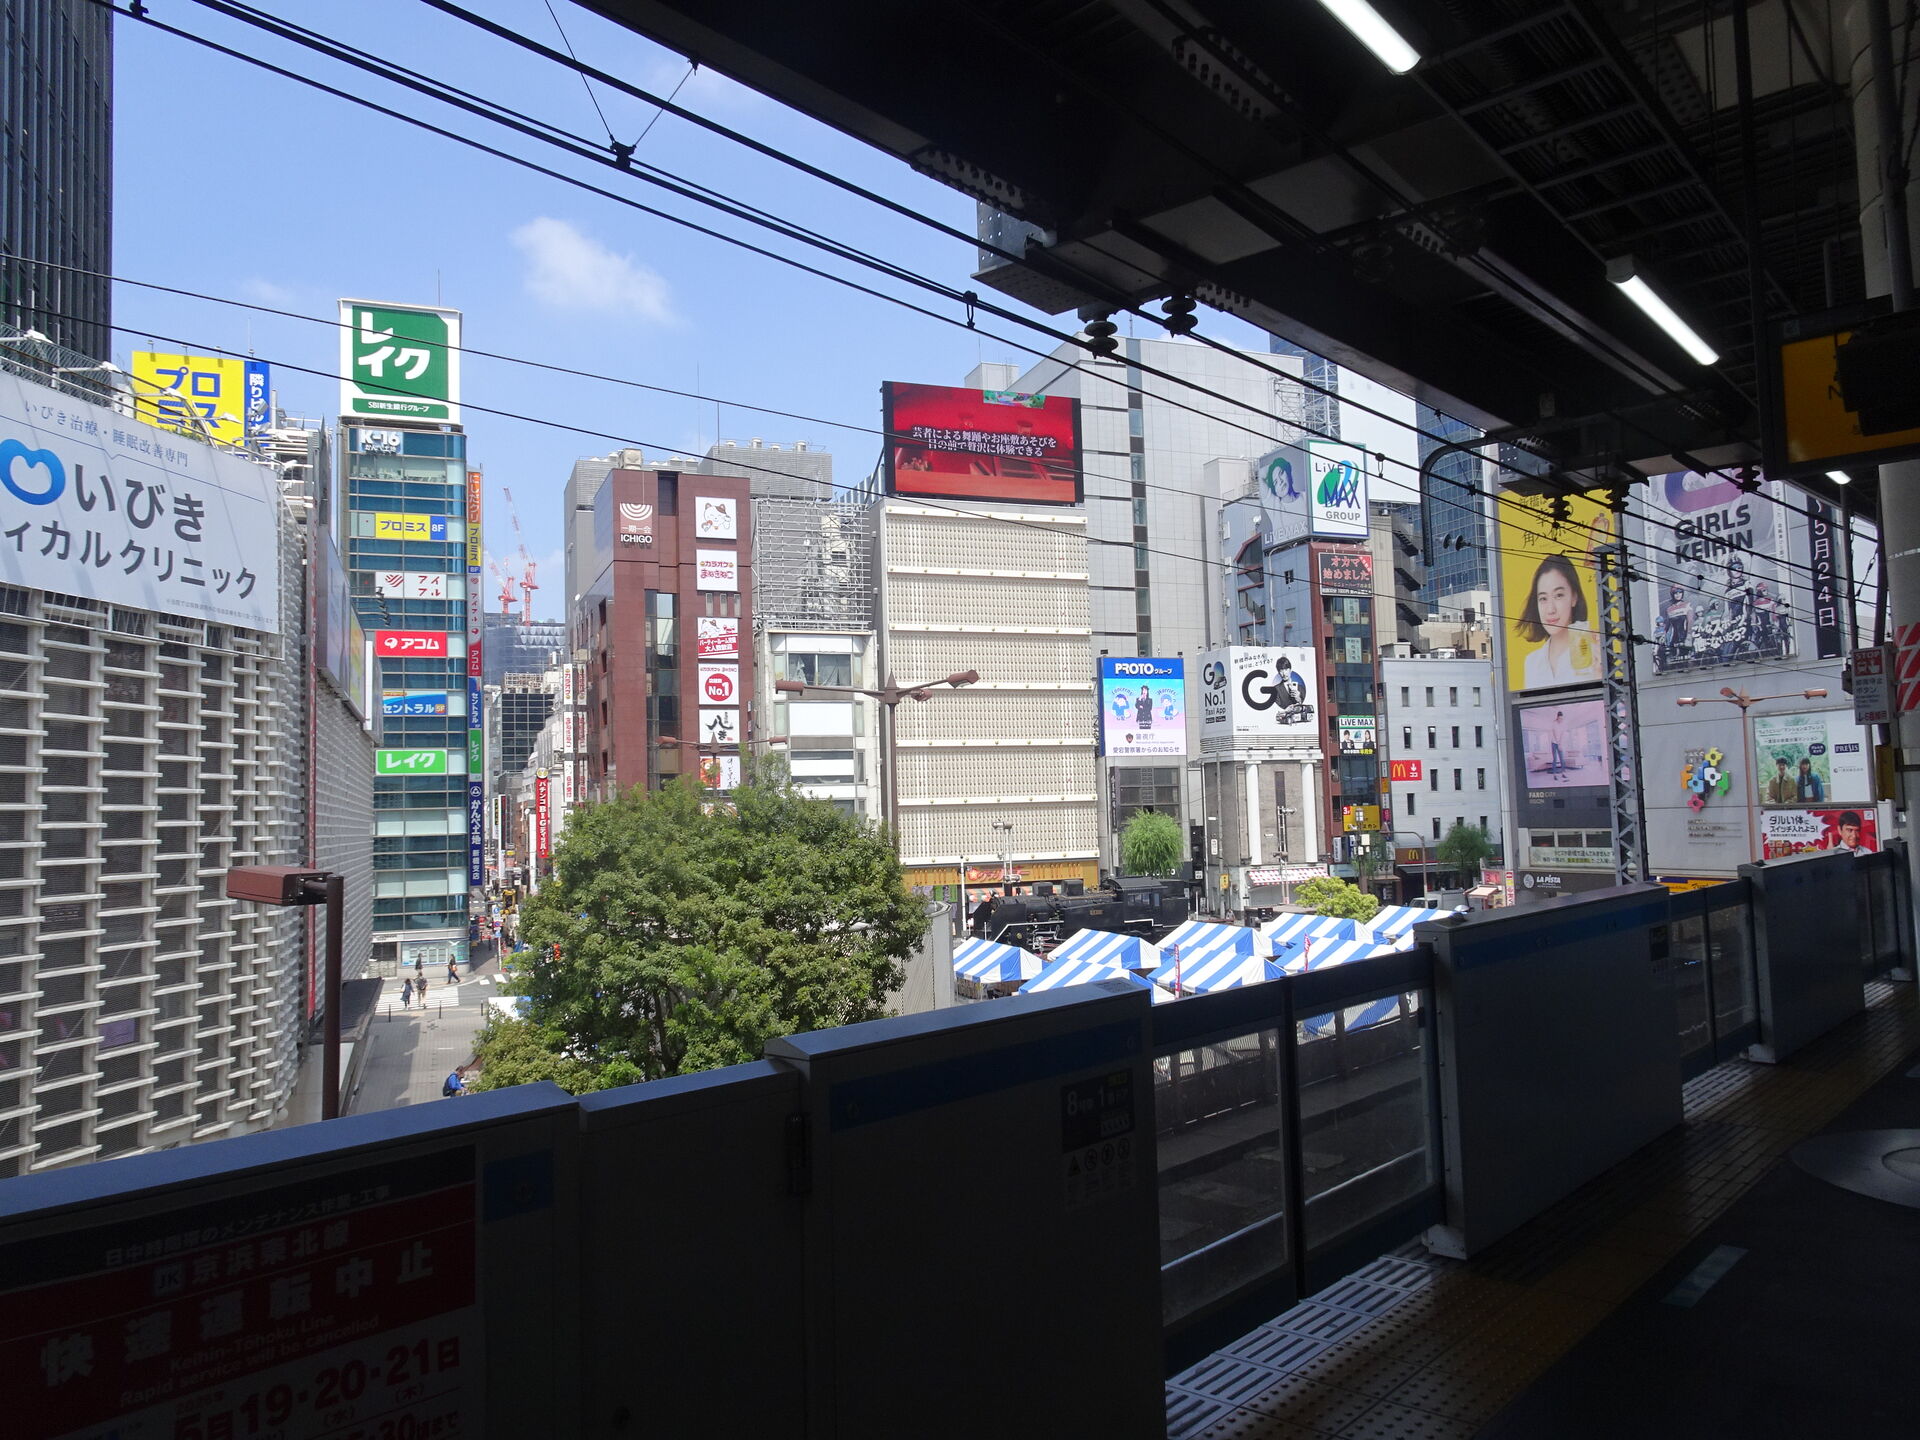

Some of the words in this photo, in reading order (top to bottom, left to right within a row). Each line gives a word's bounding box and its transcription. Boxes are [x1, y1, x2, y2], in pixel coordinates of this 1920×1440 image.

[358, 346, 431, 380] イク
[156, 366, 221, 398] プロ
[25, 401, 188, 467] いびき治療・睡眠改善専門
[1315, 462, 1344, 475] LiVE
[1323, 479, 1361, 510] MAX
[75, 463, 205, 543] いびき
[1325, 510, 1361, 521] GROUP
[1674, 503, 1751, 541] GIRLS
[380, 520, 427, 533] プロミス
[431, 523, 445, 533] 8F
[621, 525, 652, 534] 一期一会
[470, 528, 479, 561] プロミス
[620, 534, 653, 544] ICHIGO
[1675, 529, 1754, 565] KEIRIN
[704, 560, 730, 568] カラオケ
[700, 569, 735, 580] まねきねこ
[1322, 568, 1370, 581] 始めました
[400, 638, 440, 651] アコム
[471, 650, 480, 671] アコム
[708, 682, 730, 697] No.1
[1204, 692, 1226, 706] No.1
[471, 692, 479, 724] セントラル
[1340, 718, 1356, 727] LiVE
[1357, 717, 1374, 727] MAX
[471, 740, 479, 762] レイク
[385, 753, 436, 769] レイク
[470, 800, 482, 845] かんべ土地
[1770, 825, 1819, 833] スイッチ入れよう!
[1536, 876, 1545, 884] LA
[1545, 875, 1561, 884] PISTA
[301, 1313, 337, 1335] Line
[303, 1315, 381, 1350] cancelled
